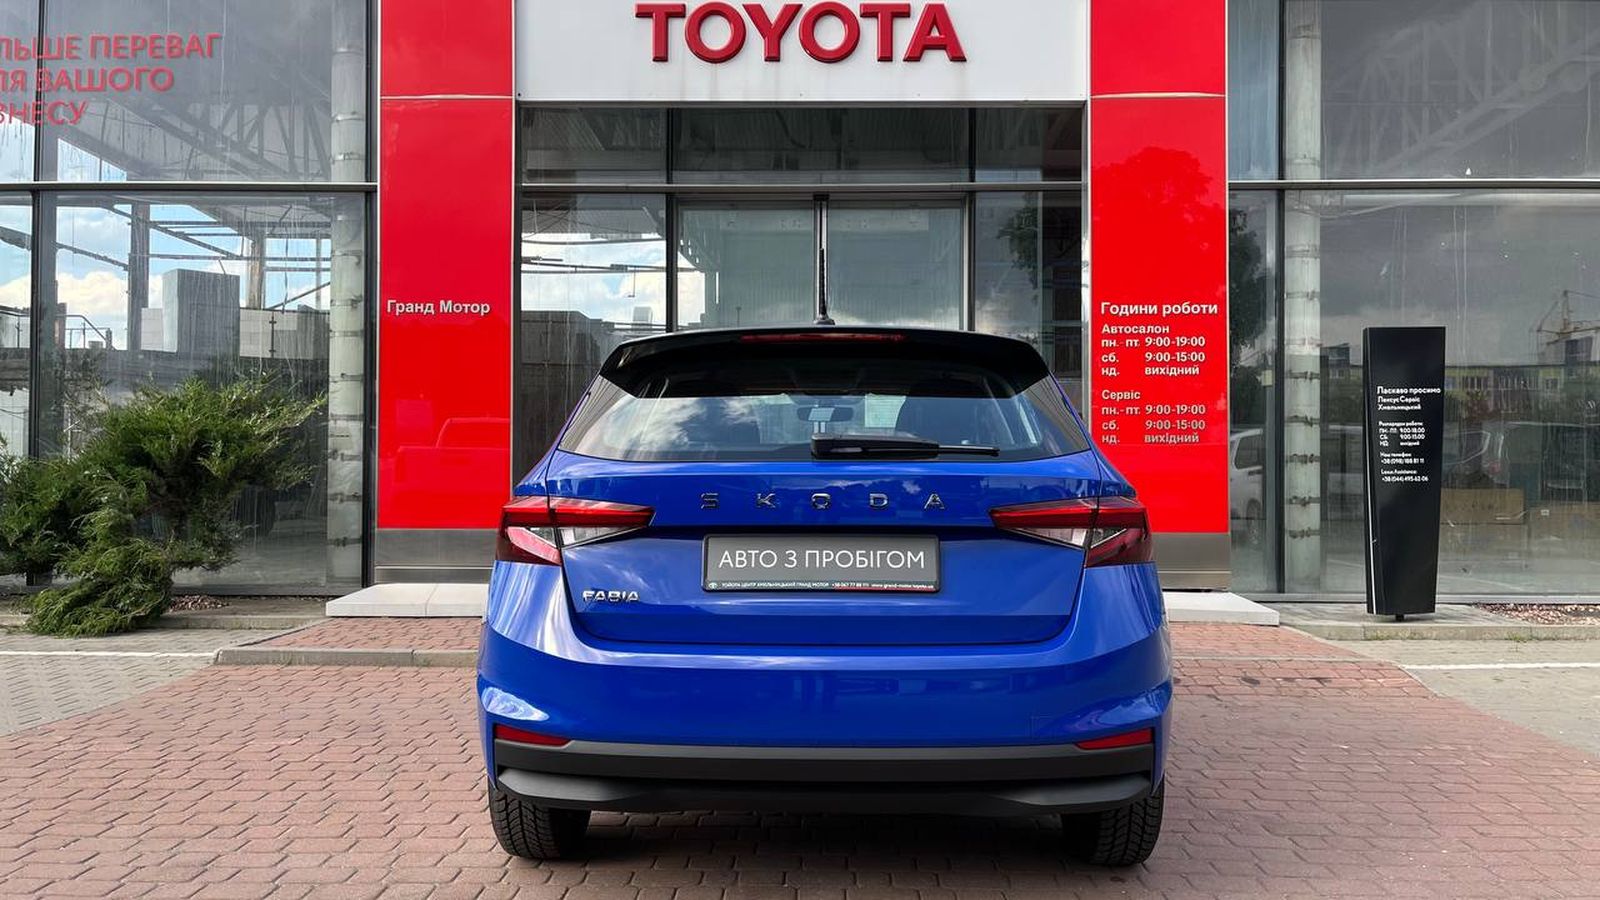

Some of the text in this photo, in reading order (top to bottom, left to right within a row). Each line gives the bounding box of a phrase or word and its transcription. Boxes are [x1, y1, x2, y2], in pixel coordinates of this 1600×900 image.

[635, 1, 968, 64] TOYOTA
[89, 33, 222, 60] ПЕРЕВАГ
[35, 66, 176, 92] ВАШОГО
[387, 299, 491, 316] Гранд Мотор
[1101, 301, 1218, 317] Години роботи
[1101, 323, 1170, 334] Автосалон
[1145, 336, 1206, 347] 9:00-19:00
[1101, 351, 1206, 362] сб. 9:00-15:00
[1101, 364, 1200, 376] нд. вихідний
[1101, 389, 1141, 401] Сервіс
[1377, 386, 1408, 394] Ласкаво
[1145, 404, 1206, 415] 9:00-19:00
[1101, 419, 1206, 430] сб. 9:00-15:00
[1101, 433, 1200, 444] нд. вихідний
[718, 550, 926, 569] АВТО З ПРОБІГОМ
[583, 590, 639, 602] FABIA
